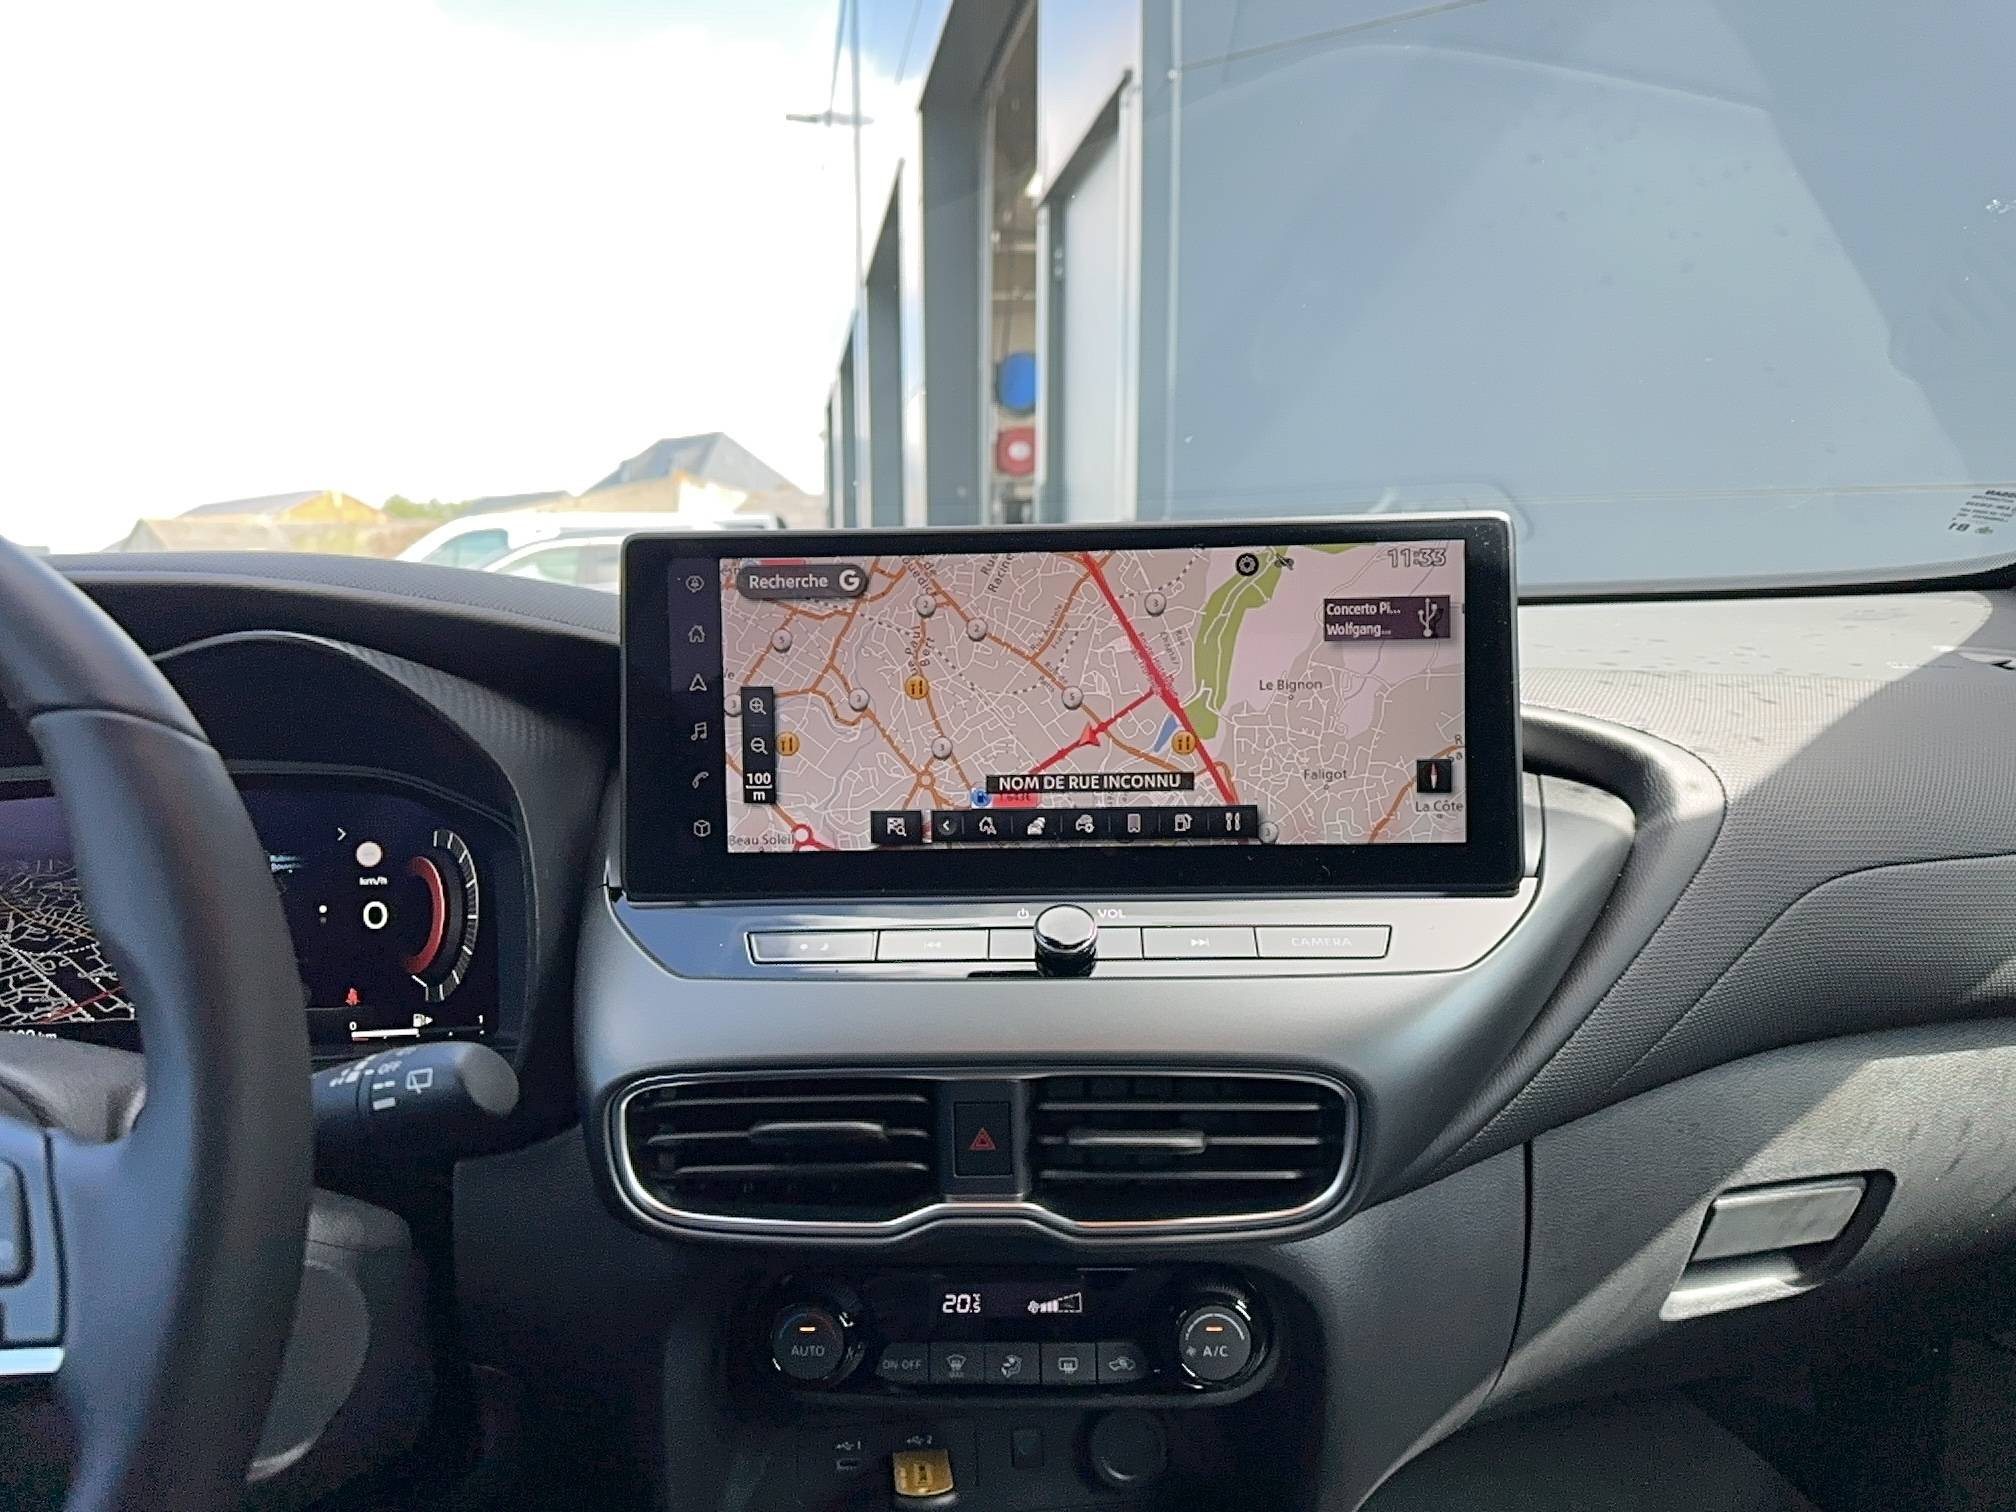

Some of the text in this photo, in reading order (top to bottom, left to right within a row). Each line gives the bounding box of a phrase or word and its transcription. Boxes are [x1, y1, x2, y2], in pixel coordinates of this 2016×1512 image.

[748, 573, 829, 589] Recherche
[839, 569, 860, 592] G
[1326, 602, 1377, 616] Concerto
[1259, 679, 1323, 693] Le Bignon
[746, 773, 772, 785] 100
[1303, 768, 1347, 783] Faligot
[999, 774, 1182, 791] NOM DE RUE INCONNU
[752, 791, 766, 801] m
[1415, 800, 1464, 813] La Côte
[729, 833, 795, 846] Beau Soleil
[363, 901, 388, 930] 0
[1097, 908, 1127, 920] VOL
[1291, 936, 1352, 947] CAMERA
[791, 1345, 825, 1357] AUTO
[1202, 1345, 1229, 1358] A/C
